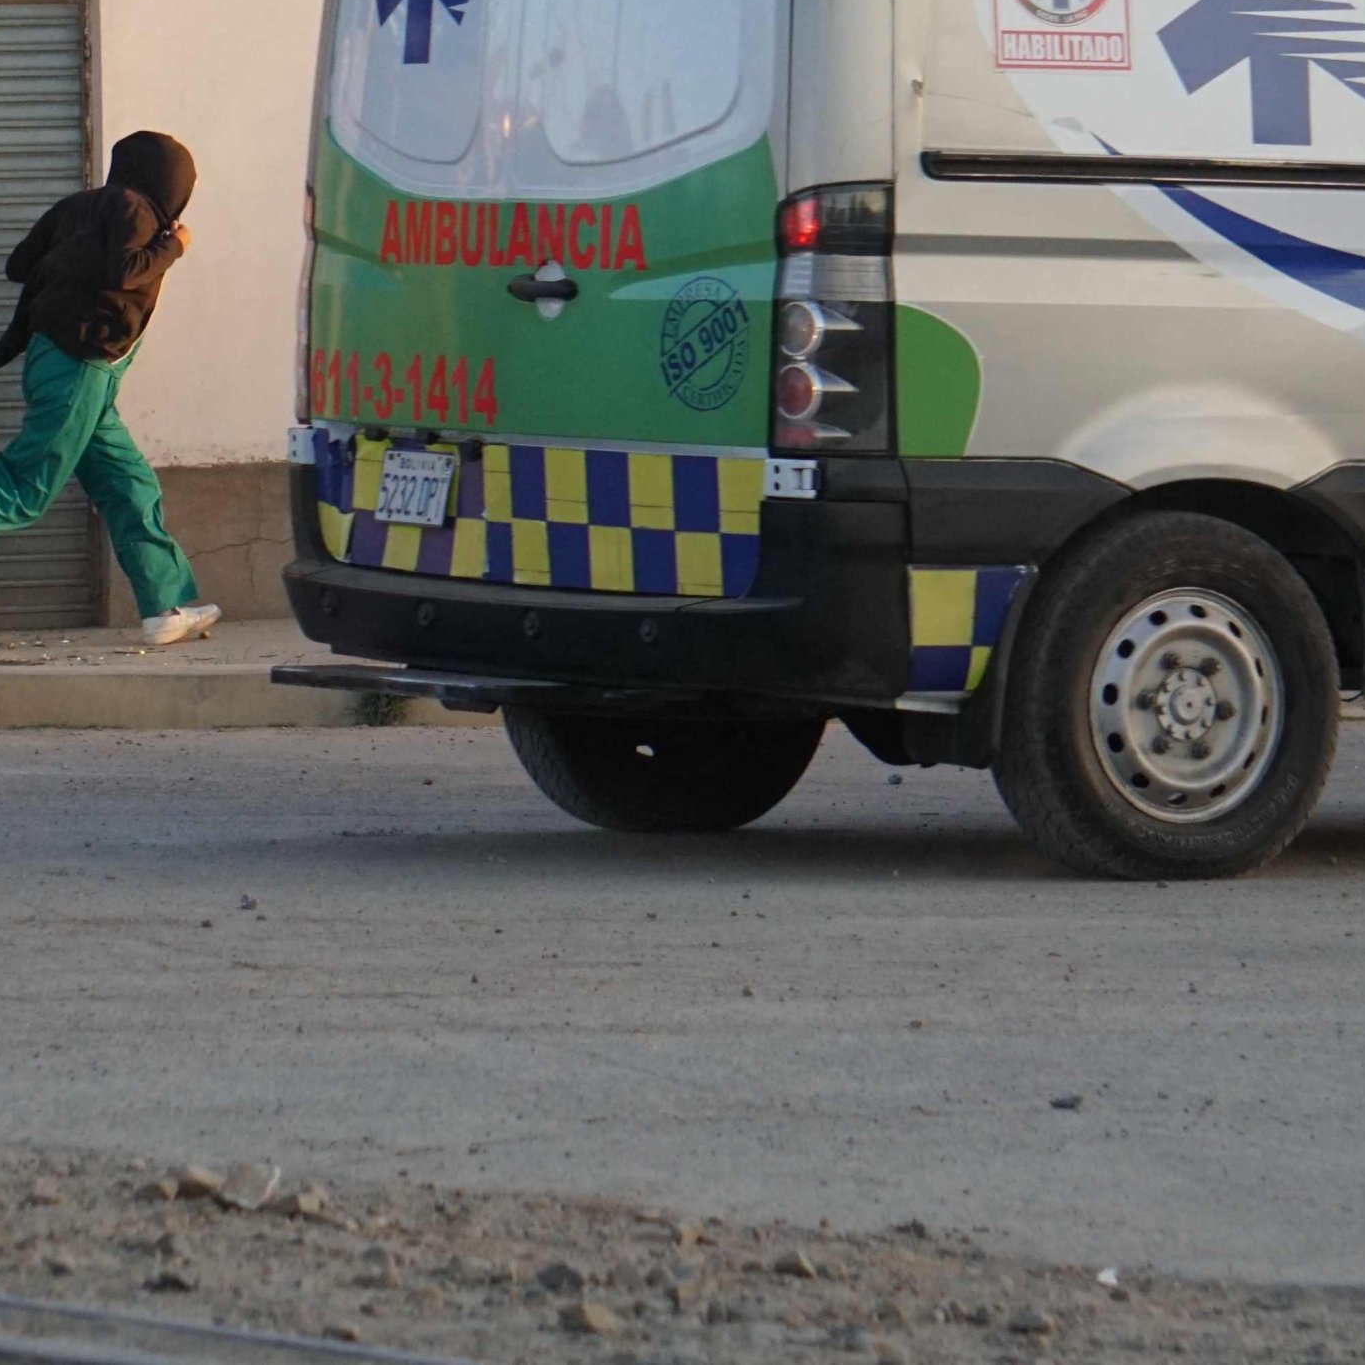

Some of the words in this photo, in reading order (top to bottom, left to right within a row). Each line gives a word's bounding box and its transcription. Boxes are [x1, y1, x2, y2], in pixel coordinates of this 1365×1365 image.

[1002, 31, 1123, 63] HABILITADO
[379, 200, 648, 271] AMBULANCIA
[661, 342, 697, 389] ISO
[698, 299, 750, 354] 9001
[311, 347, 498, 427] 611-3-1414
